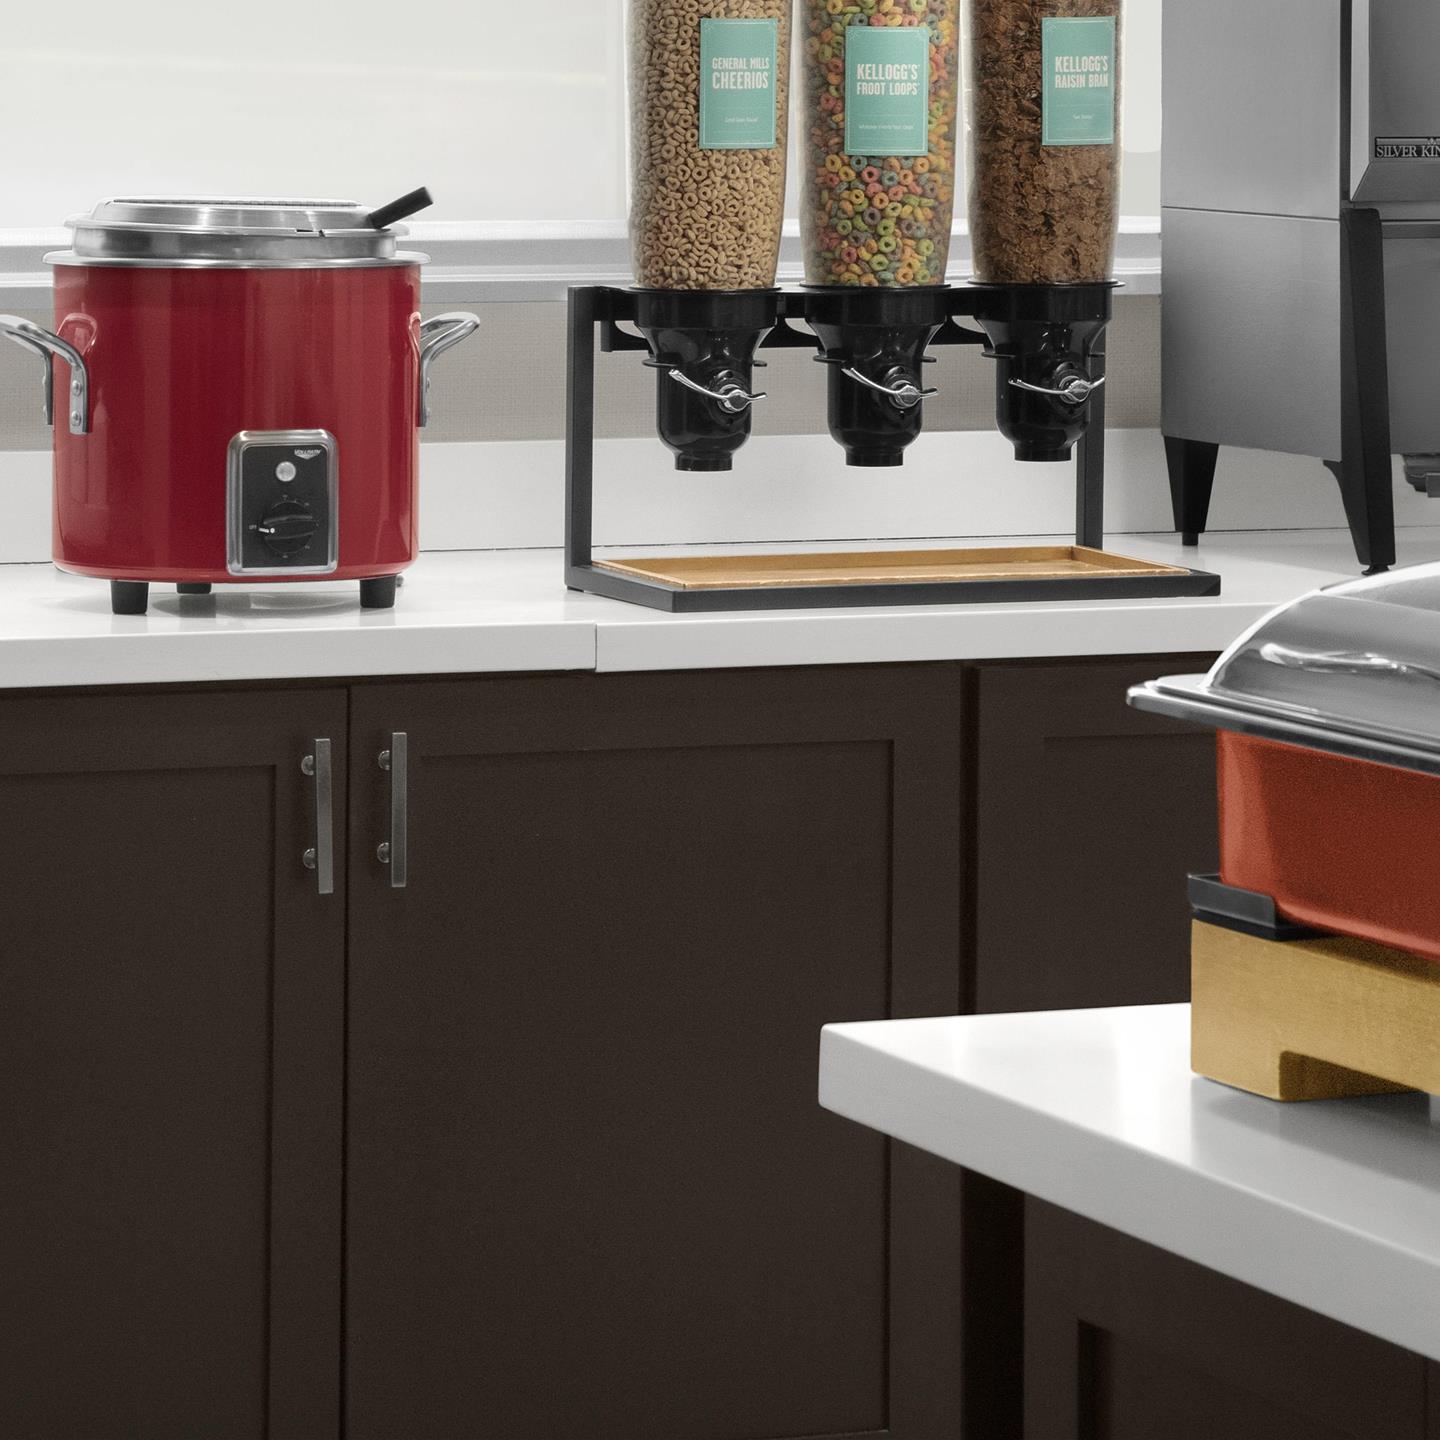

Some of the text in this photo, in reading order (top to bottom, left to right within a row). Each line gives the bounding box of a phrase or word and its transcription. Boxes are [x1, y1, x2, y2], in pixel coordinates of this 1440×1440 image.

[712, 57, 769, 70] GENERAL MILLS
[1055, 56, 1108, 72] KELLOGG'S
[856, 64, 919, 80] KELLOGG'S
[712, 71, 769, 89] CHEERIOS
[1055, 73, 1109, 88] RAISIN BRAN
[856, 82, 919, 96] FROOT LOOPS
[1376, 145, 1417, 157] SILVER
